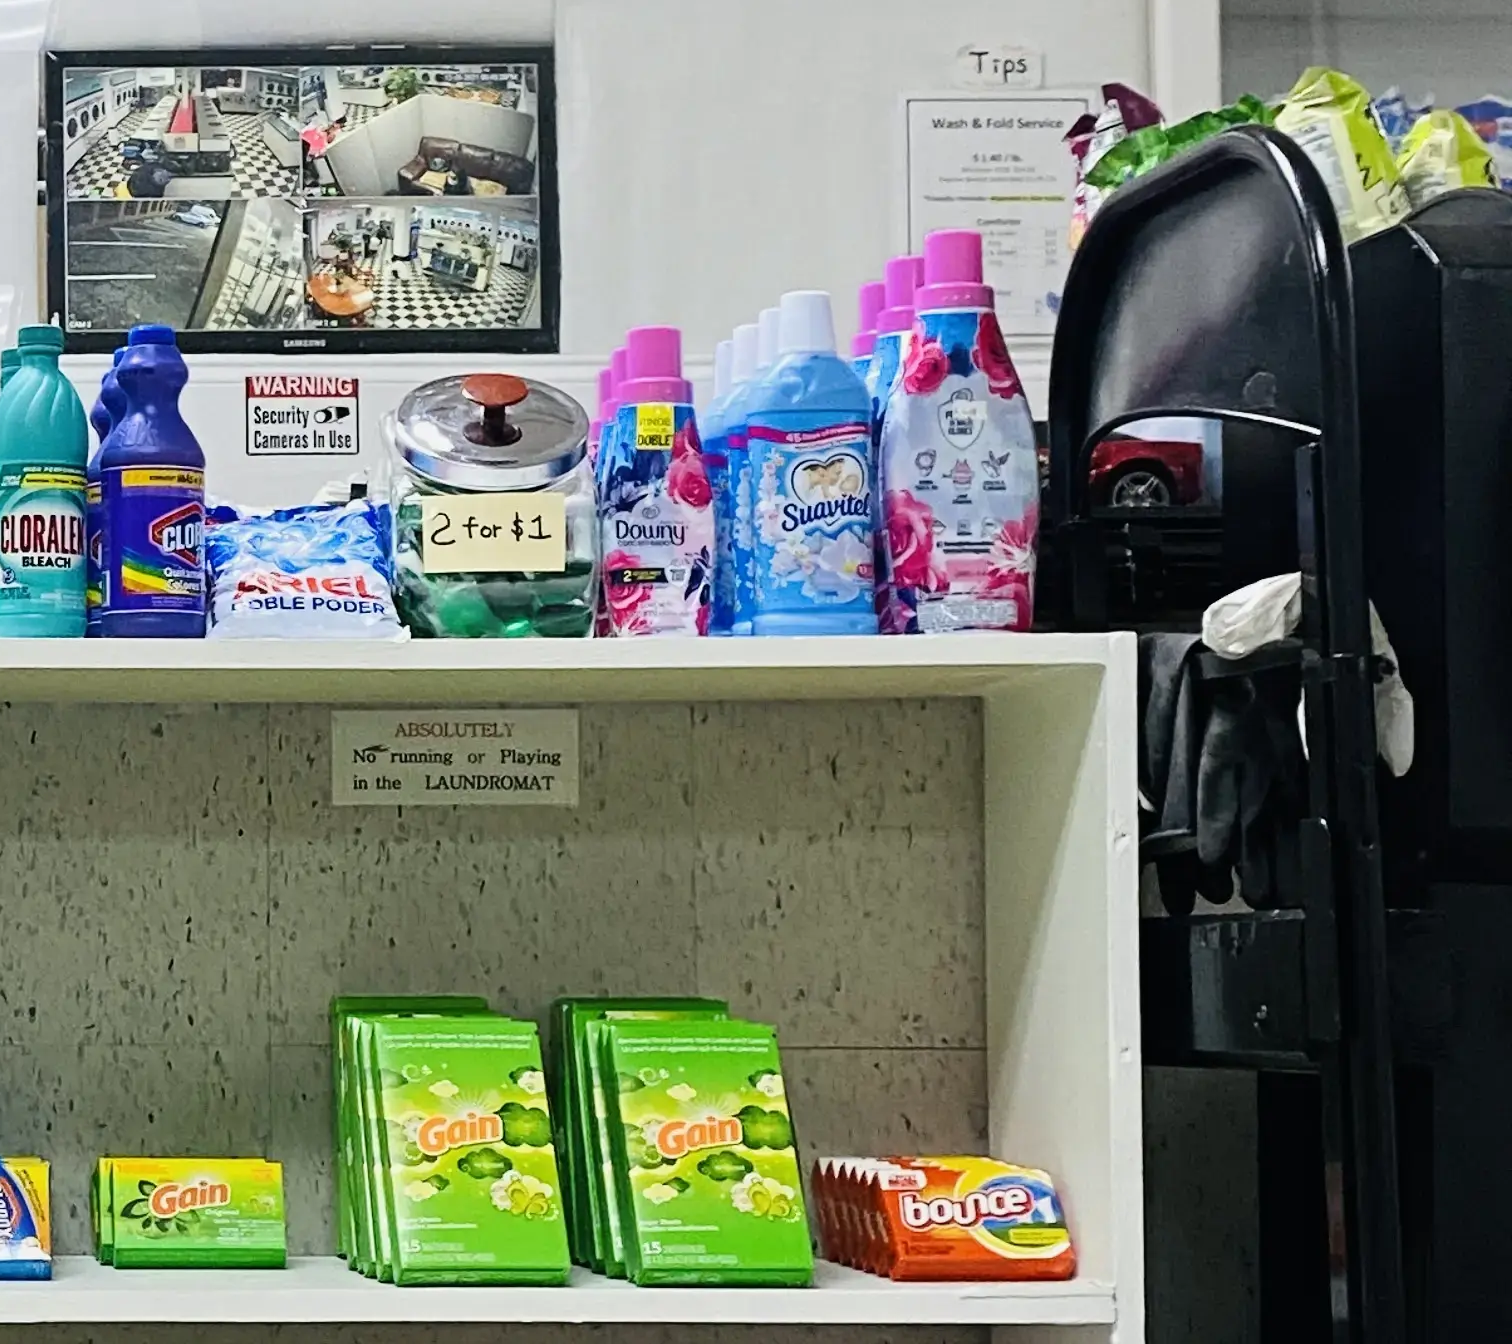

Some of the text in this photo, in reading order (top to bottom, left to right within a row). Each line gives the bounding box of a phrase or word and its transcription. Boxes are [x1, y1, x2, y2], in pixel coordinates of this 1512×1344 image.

[968, 50, 1029, 84] Tips
[931, 117, 1065, 129] Wash & Fold Service
[283, 338, 327, 348] SAMSUNG
[251, 375, 354, 396] WARNING
[253, 405, 310, 429] Security
[253, 429, 352, 449] Cameras In Use
[781, 493, 871, 532] Suavitel
[0, 514, 86, 555] CLORALEN
[430, 511, 553, 546] 2 for $1
[615, 519, 687, 547] Downy
[21, 555, 72, 569] BLEACH
[233, 570, 382, 600] ARIEL
[231, 596, 386, 615] OBLE PODER
[394, 722, 516, 739] ABSOLUTELY
[352, 748, 562, 766] No running or Playing
[353, 774, 556, 792] in the LAUNDROMAT
[417, 1111, 500, 1152] Gain
[656, 1115, 741, 1155] Gain
[151, 1180, 229, 1215] Gain
[901, 1187, 1030, 1228] bounce
